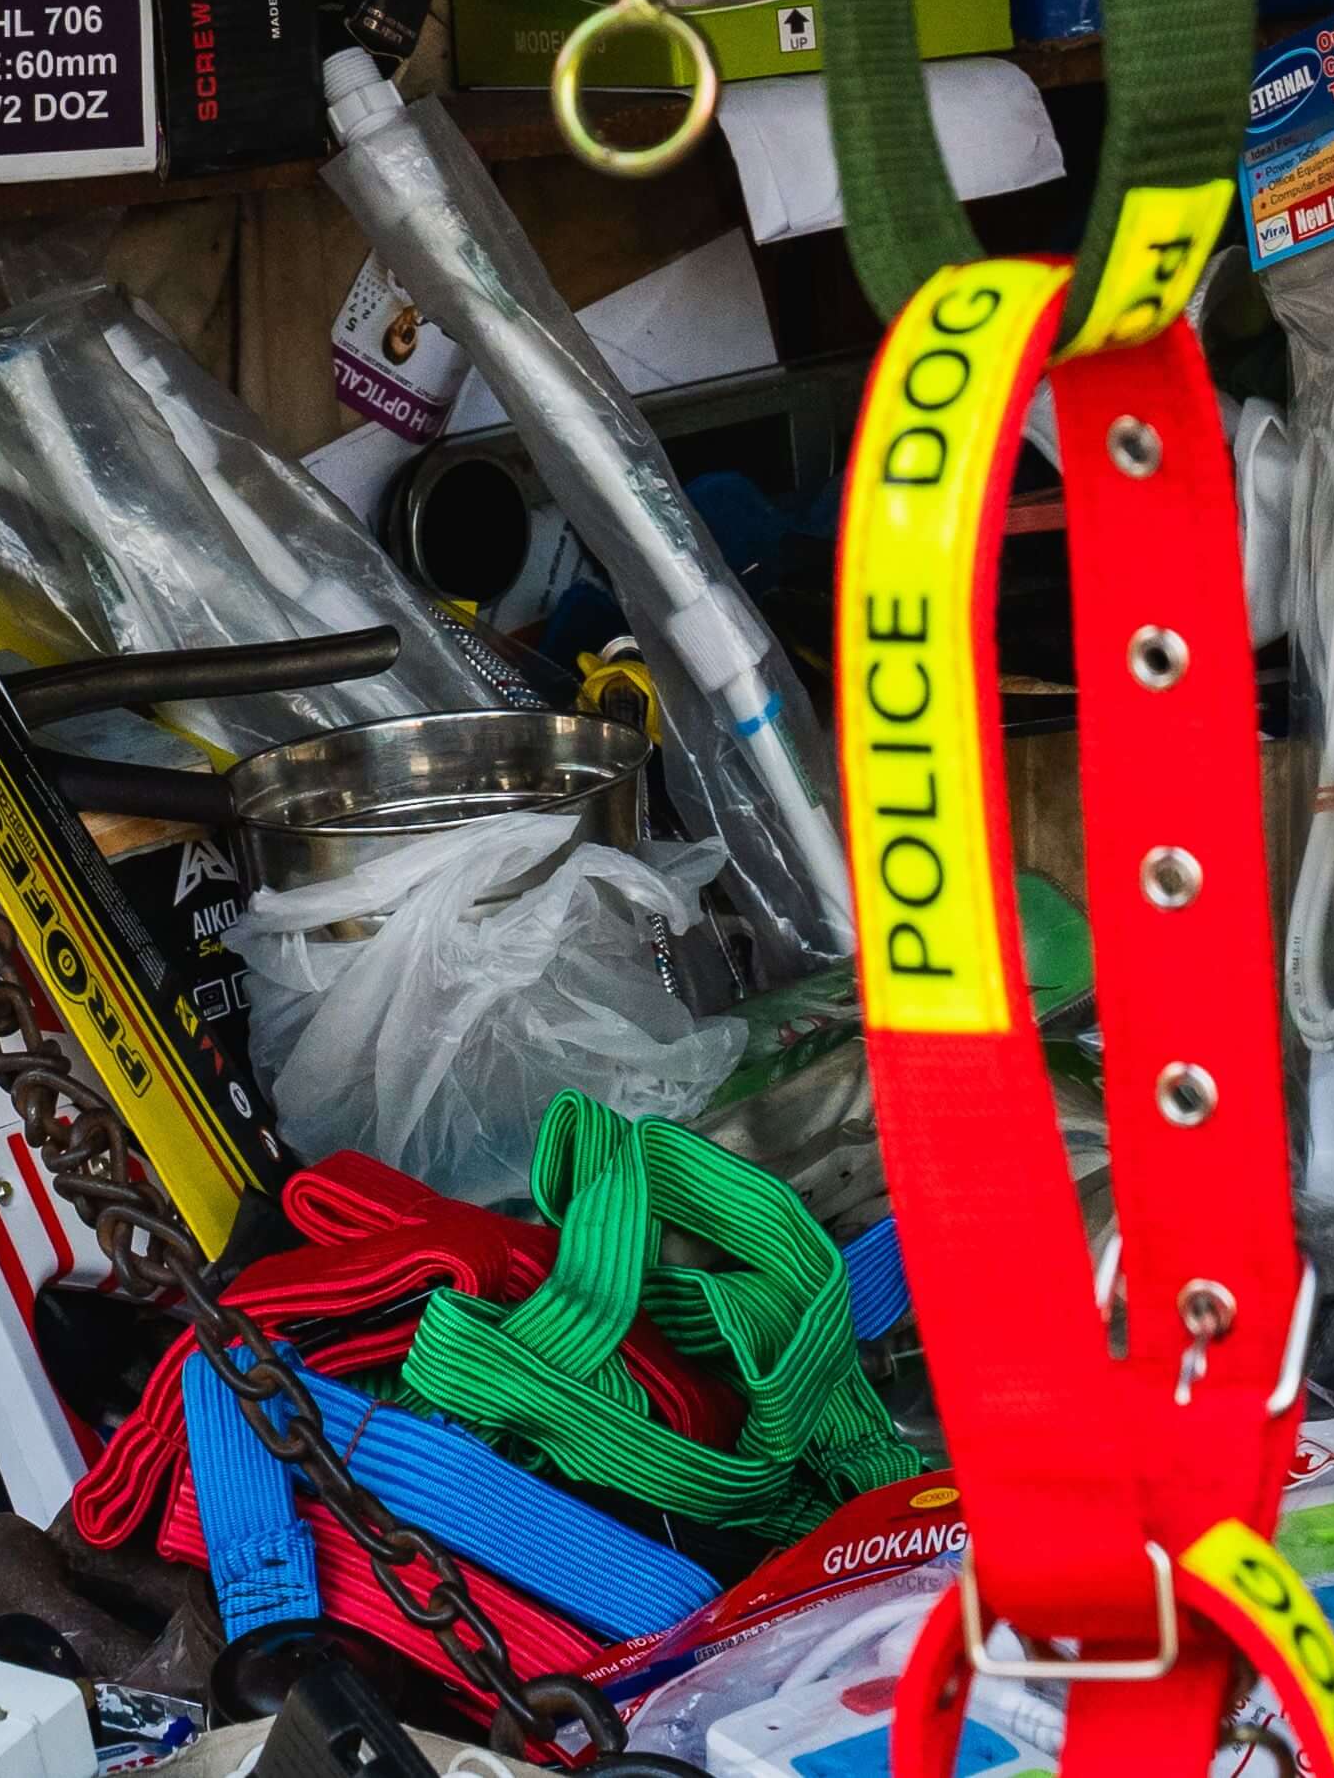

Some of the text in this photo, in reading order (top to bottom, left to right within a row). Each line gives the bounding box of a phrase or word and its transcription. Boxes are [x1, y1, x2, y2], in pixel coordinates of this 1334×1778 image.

[44, 6, 103, 35] 706
[789, 37, 808, 50] UP
[34, 90, 109, 123] DOZ
[1259, 222, 1290, 243] Viraj
[1295, 203, 1329, 236] New
[866, 283, 1003, 981] POLICE DOG
